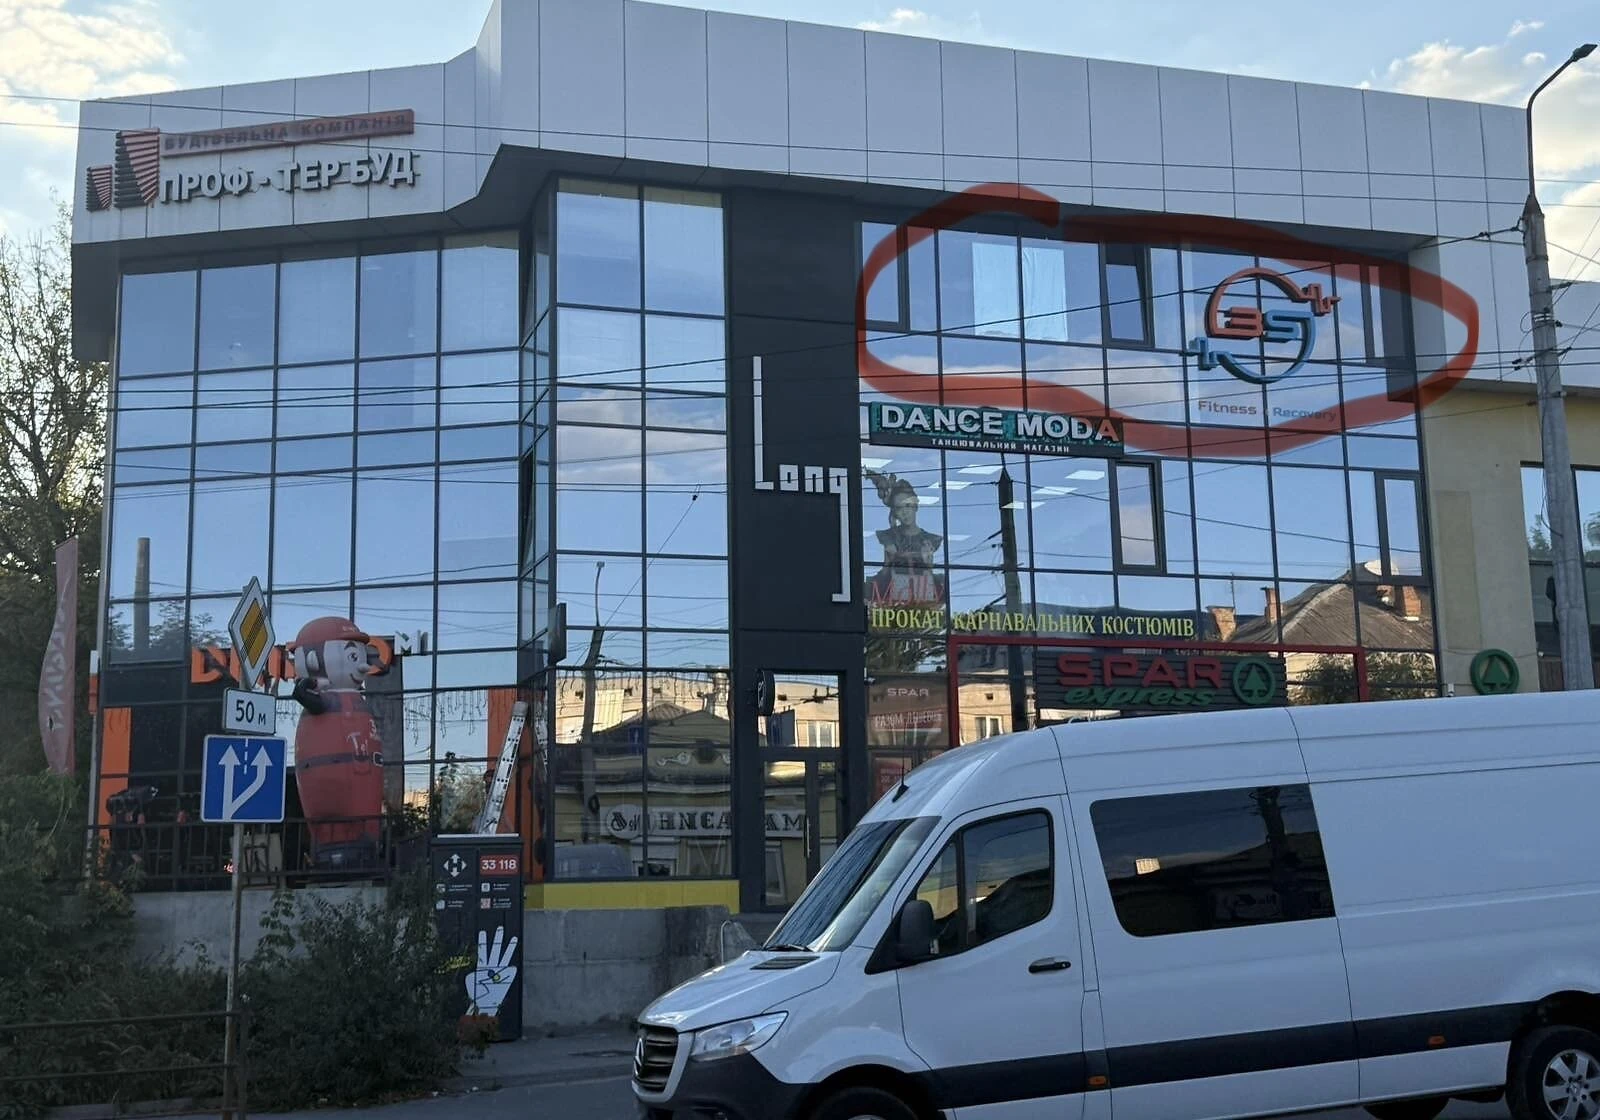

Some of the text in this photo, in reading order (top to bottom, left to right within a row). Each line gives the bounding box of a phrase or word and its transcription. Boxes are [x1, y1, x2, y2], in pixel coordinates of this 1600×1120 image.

[164, 114, 406, 150] БУДІВЕЛЬНА КОМПАНІЯ
[1198, 400, 1337, 421] Fitness Recovery
[880, 404, 1121, 442] DANCE MODA
[932, 438, 1070, 453] ТАНЦЮВАЛЬНИЙ МАГАЗИН
[752, 355, 851, 602] Long
[871, 607, 1195, 637] ПРОКАТ КАРНАВАЛЬНИХ КОСТЮМІВ
[1057, 654, 1223, 688] SPAR
[887, 687, 929, 697] SPAR
[1064, 685, 1218, 707] express
[235, 700, 255, 723] 50
[481, 859, 517, 870] 33 118
